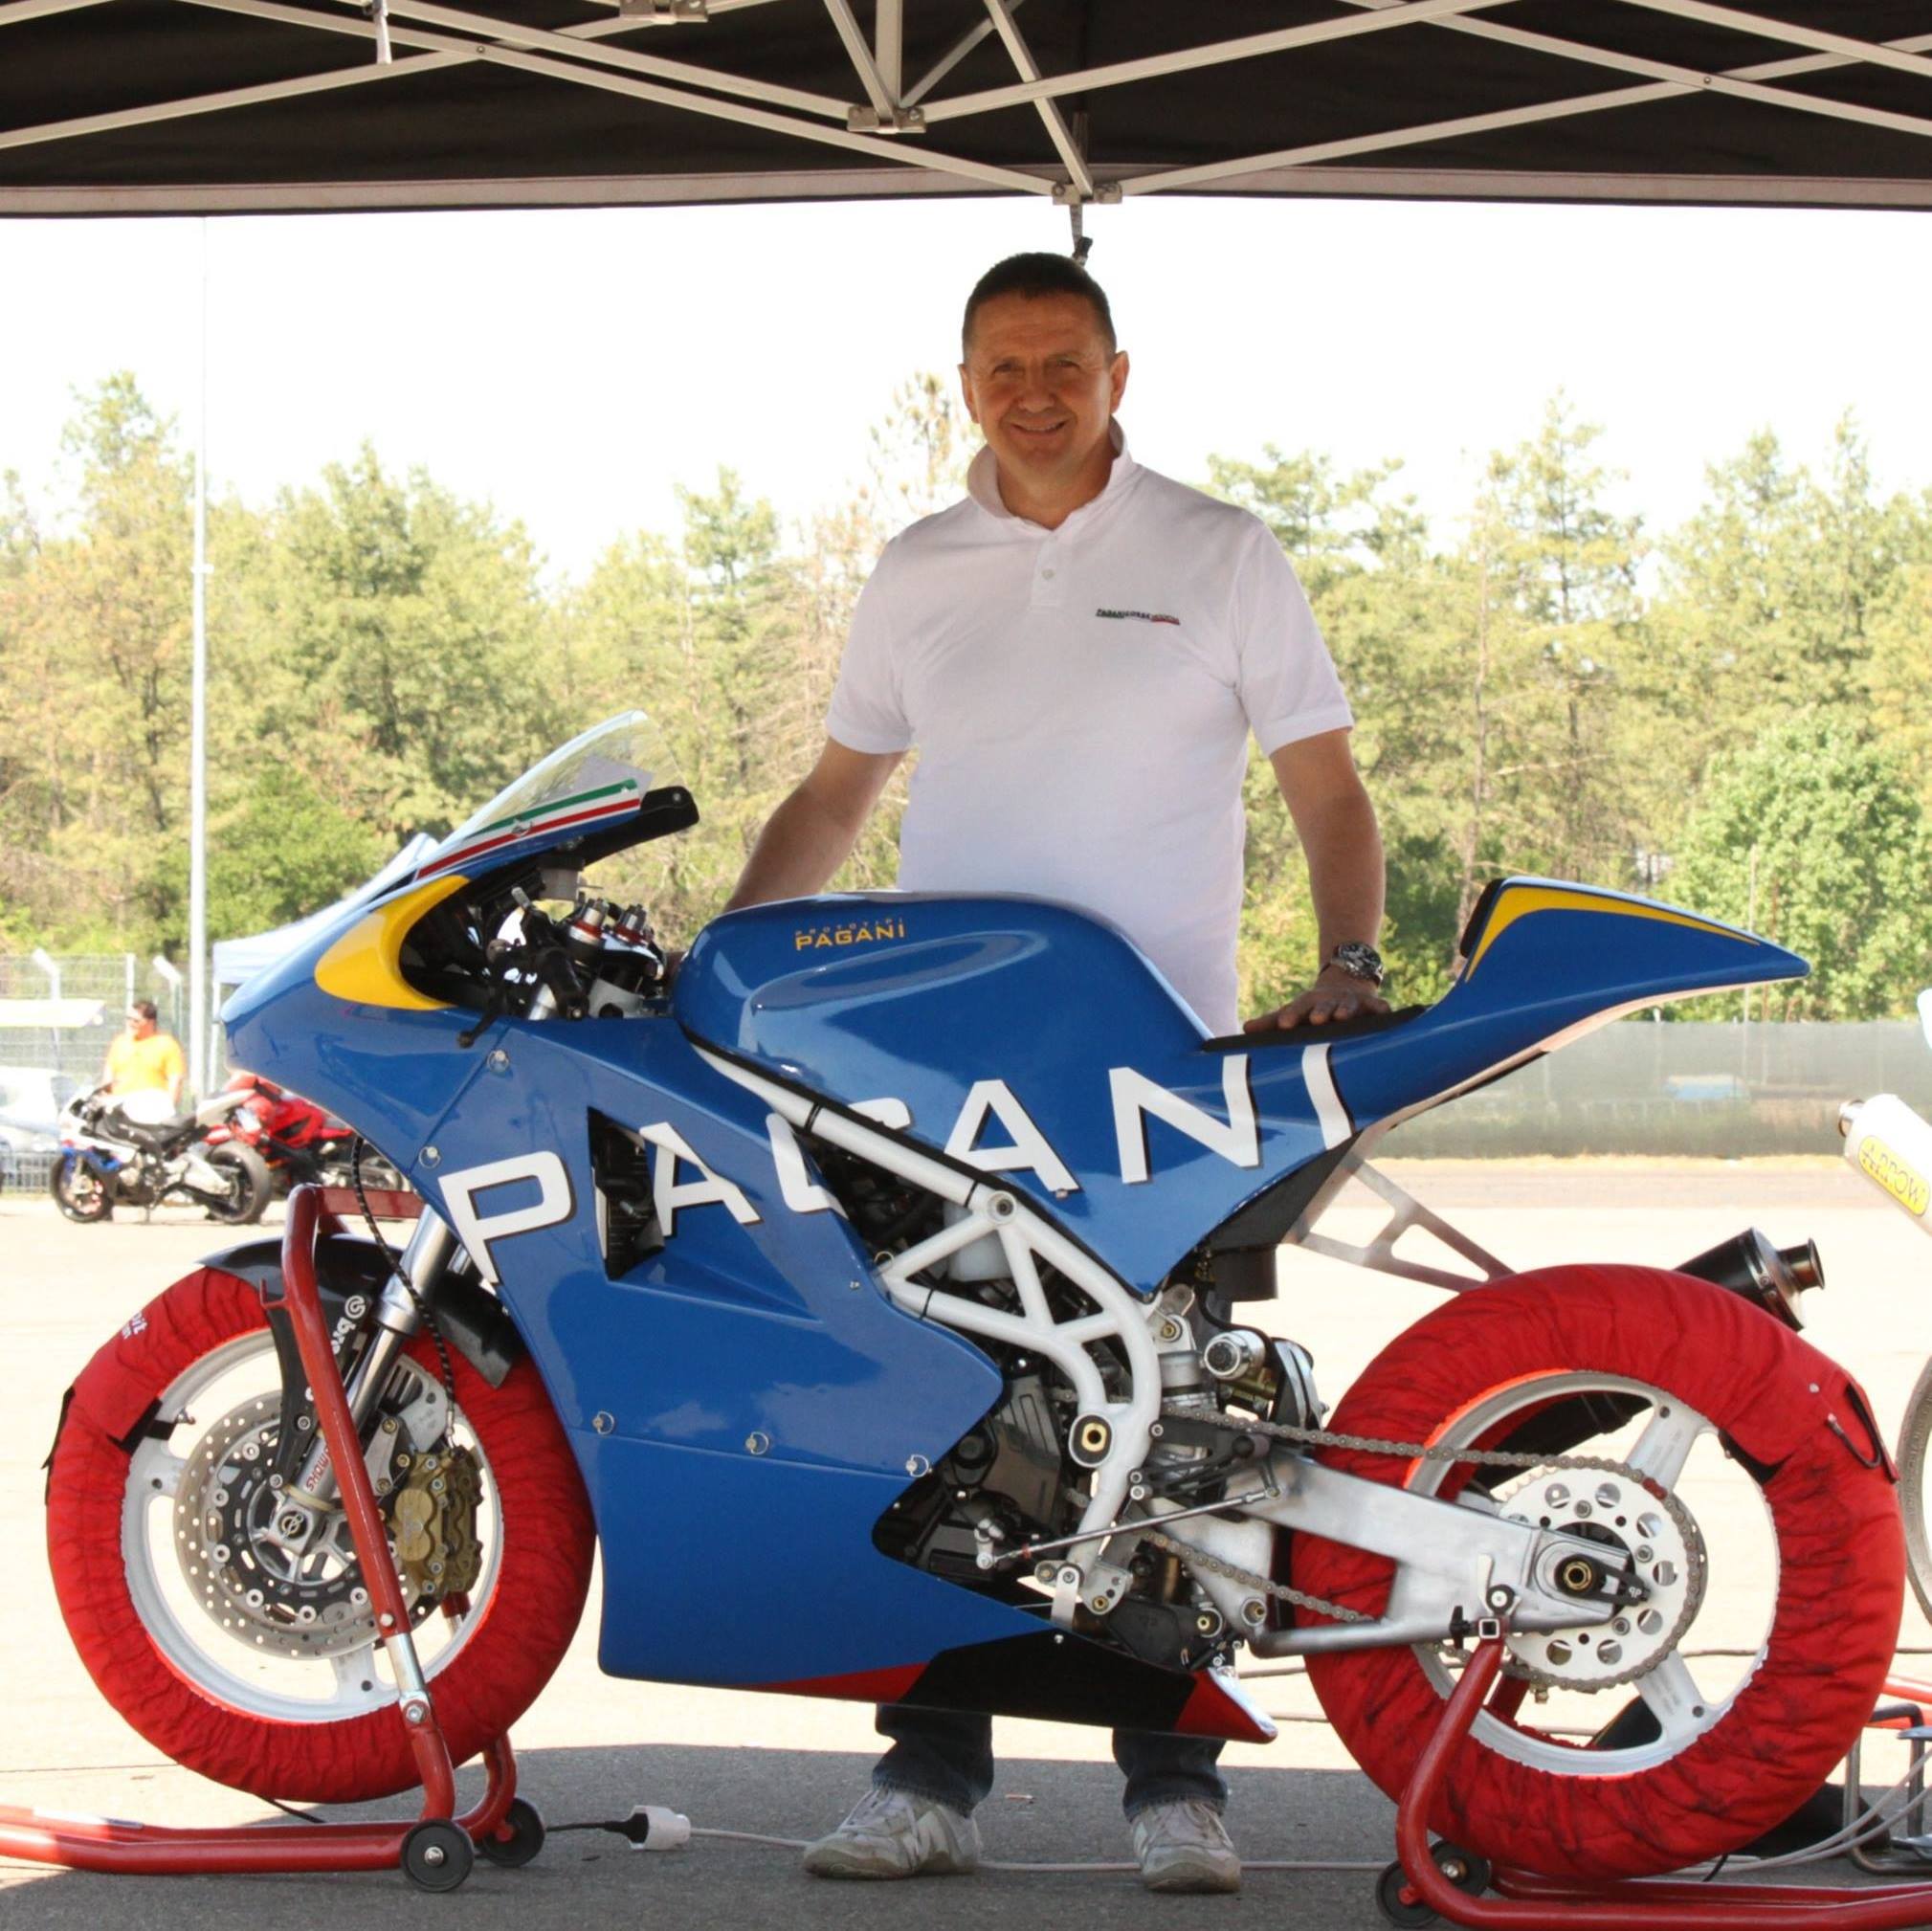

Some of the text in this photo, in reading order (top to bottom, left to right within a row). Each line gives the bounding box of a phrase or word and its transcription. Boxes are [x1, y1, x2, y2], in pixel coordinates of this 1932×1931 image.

[795, 923, 905, 951] PAGANI
[1861, 1143, 1926, 1203] ARROW
[306, 1443, 331, 1492] SHOW
